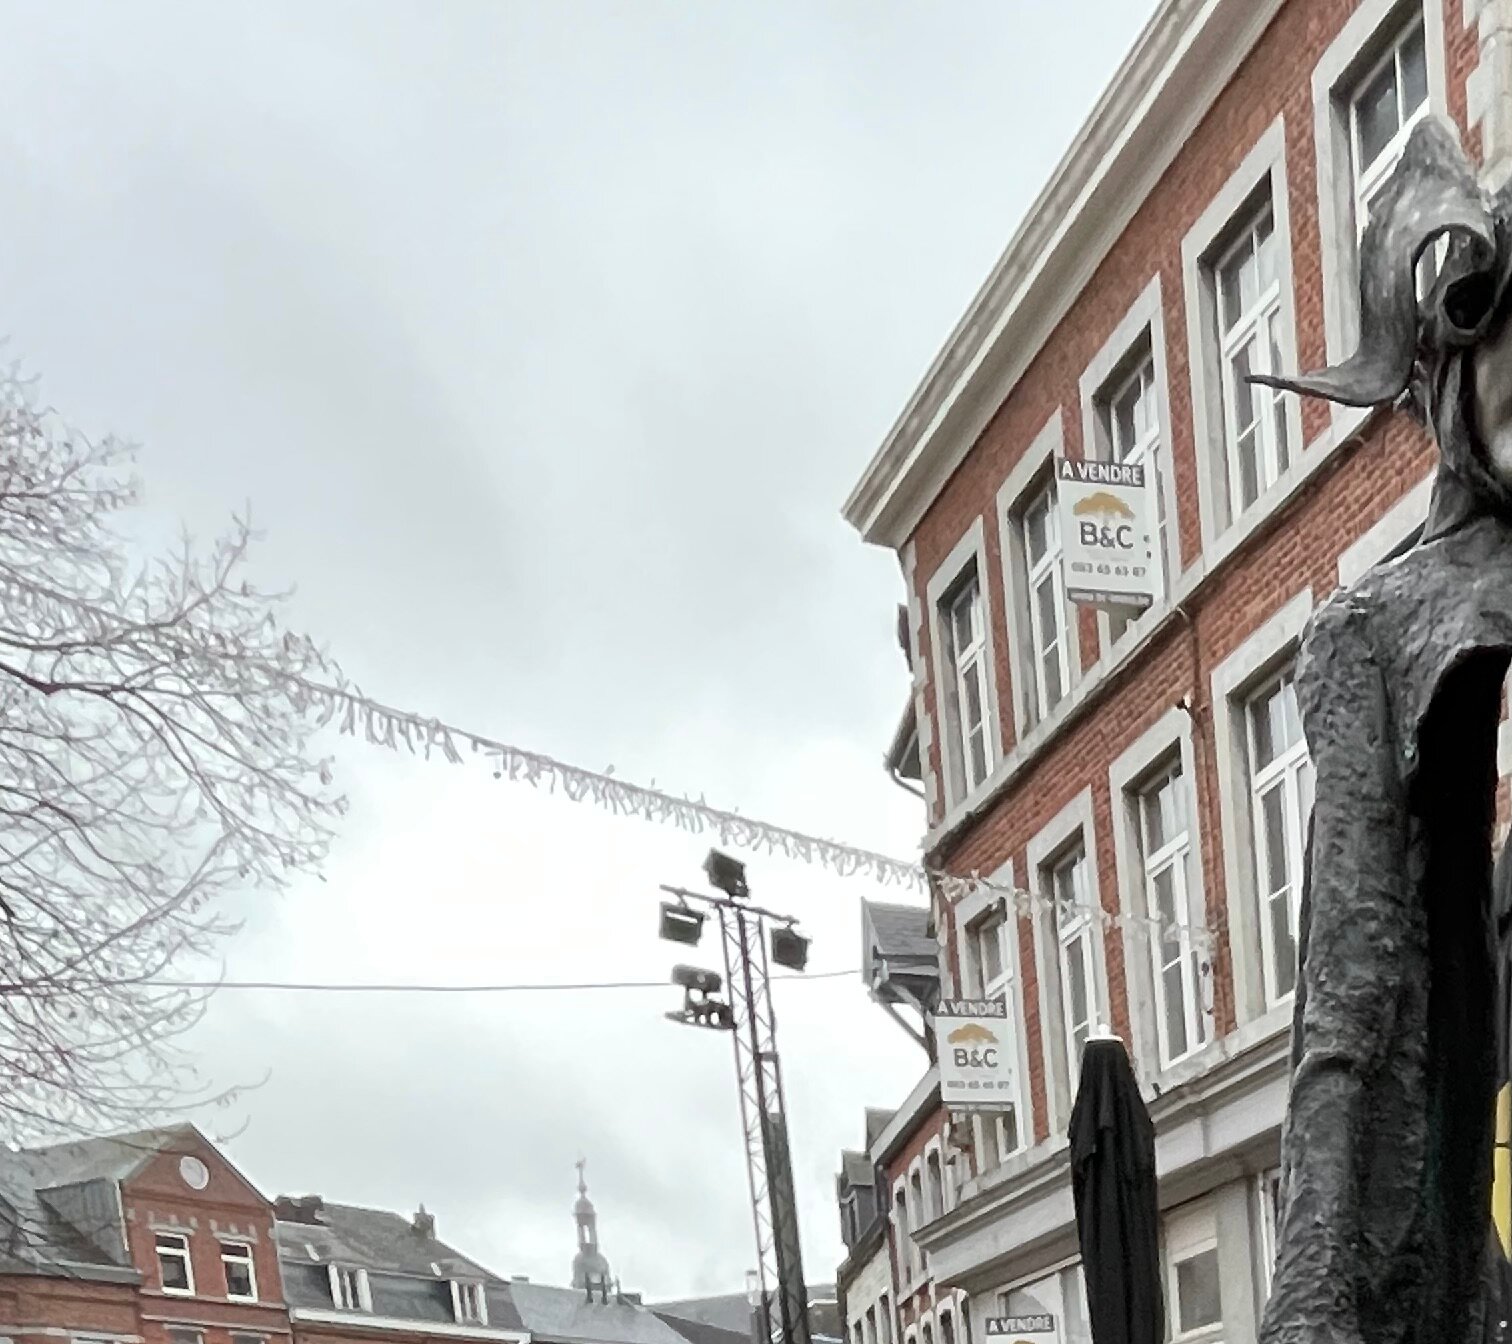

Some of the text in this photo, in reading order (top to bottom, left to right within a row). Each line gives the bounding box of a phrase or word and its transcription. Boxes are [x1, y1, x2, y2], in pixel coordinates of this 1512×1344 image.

[1077, 461, 1142, 486] VENDRE
[1080, 520, 1134, 549] B&C
[950, 1001, 1004, 1016] VENDRE
[954, 1048, 999, 1068] B&C
[1001, 1316, 1051, 1331] VENDRE
